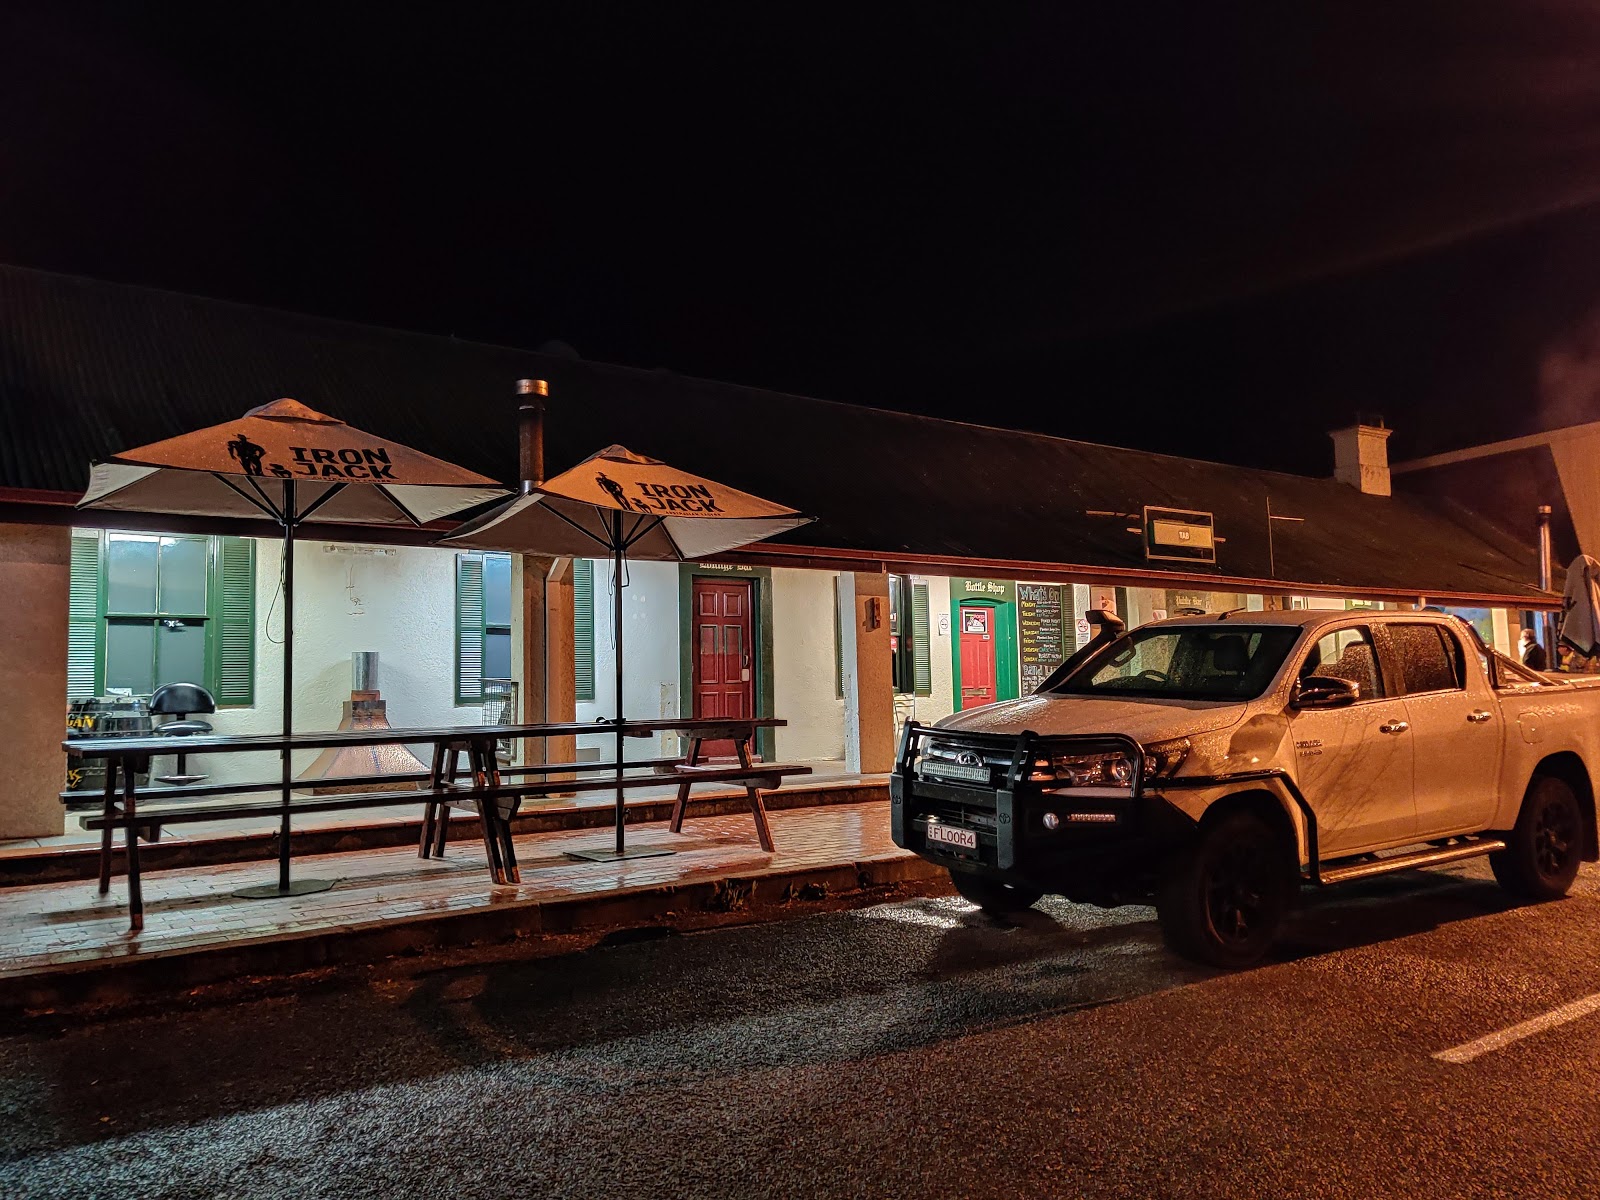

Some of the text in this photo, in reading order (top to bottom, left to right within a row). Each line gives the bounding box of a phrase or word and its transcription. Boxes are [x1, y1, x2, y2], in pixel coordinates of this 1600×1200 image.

[289, 446, 392, 465] IRON
[294, 462, 400, 480] JACK
[635, 482, 714, 499] IRON
[647, 496, 726, 513] JACK
[1179, 531, 1190, 540] TAB
[965, 580, 1005, 596] Bottle Shop
[933, 827, 974, 847] FLOOR4
